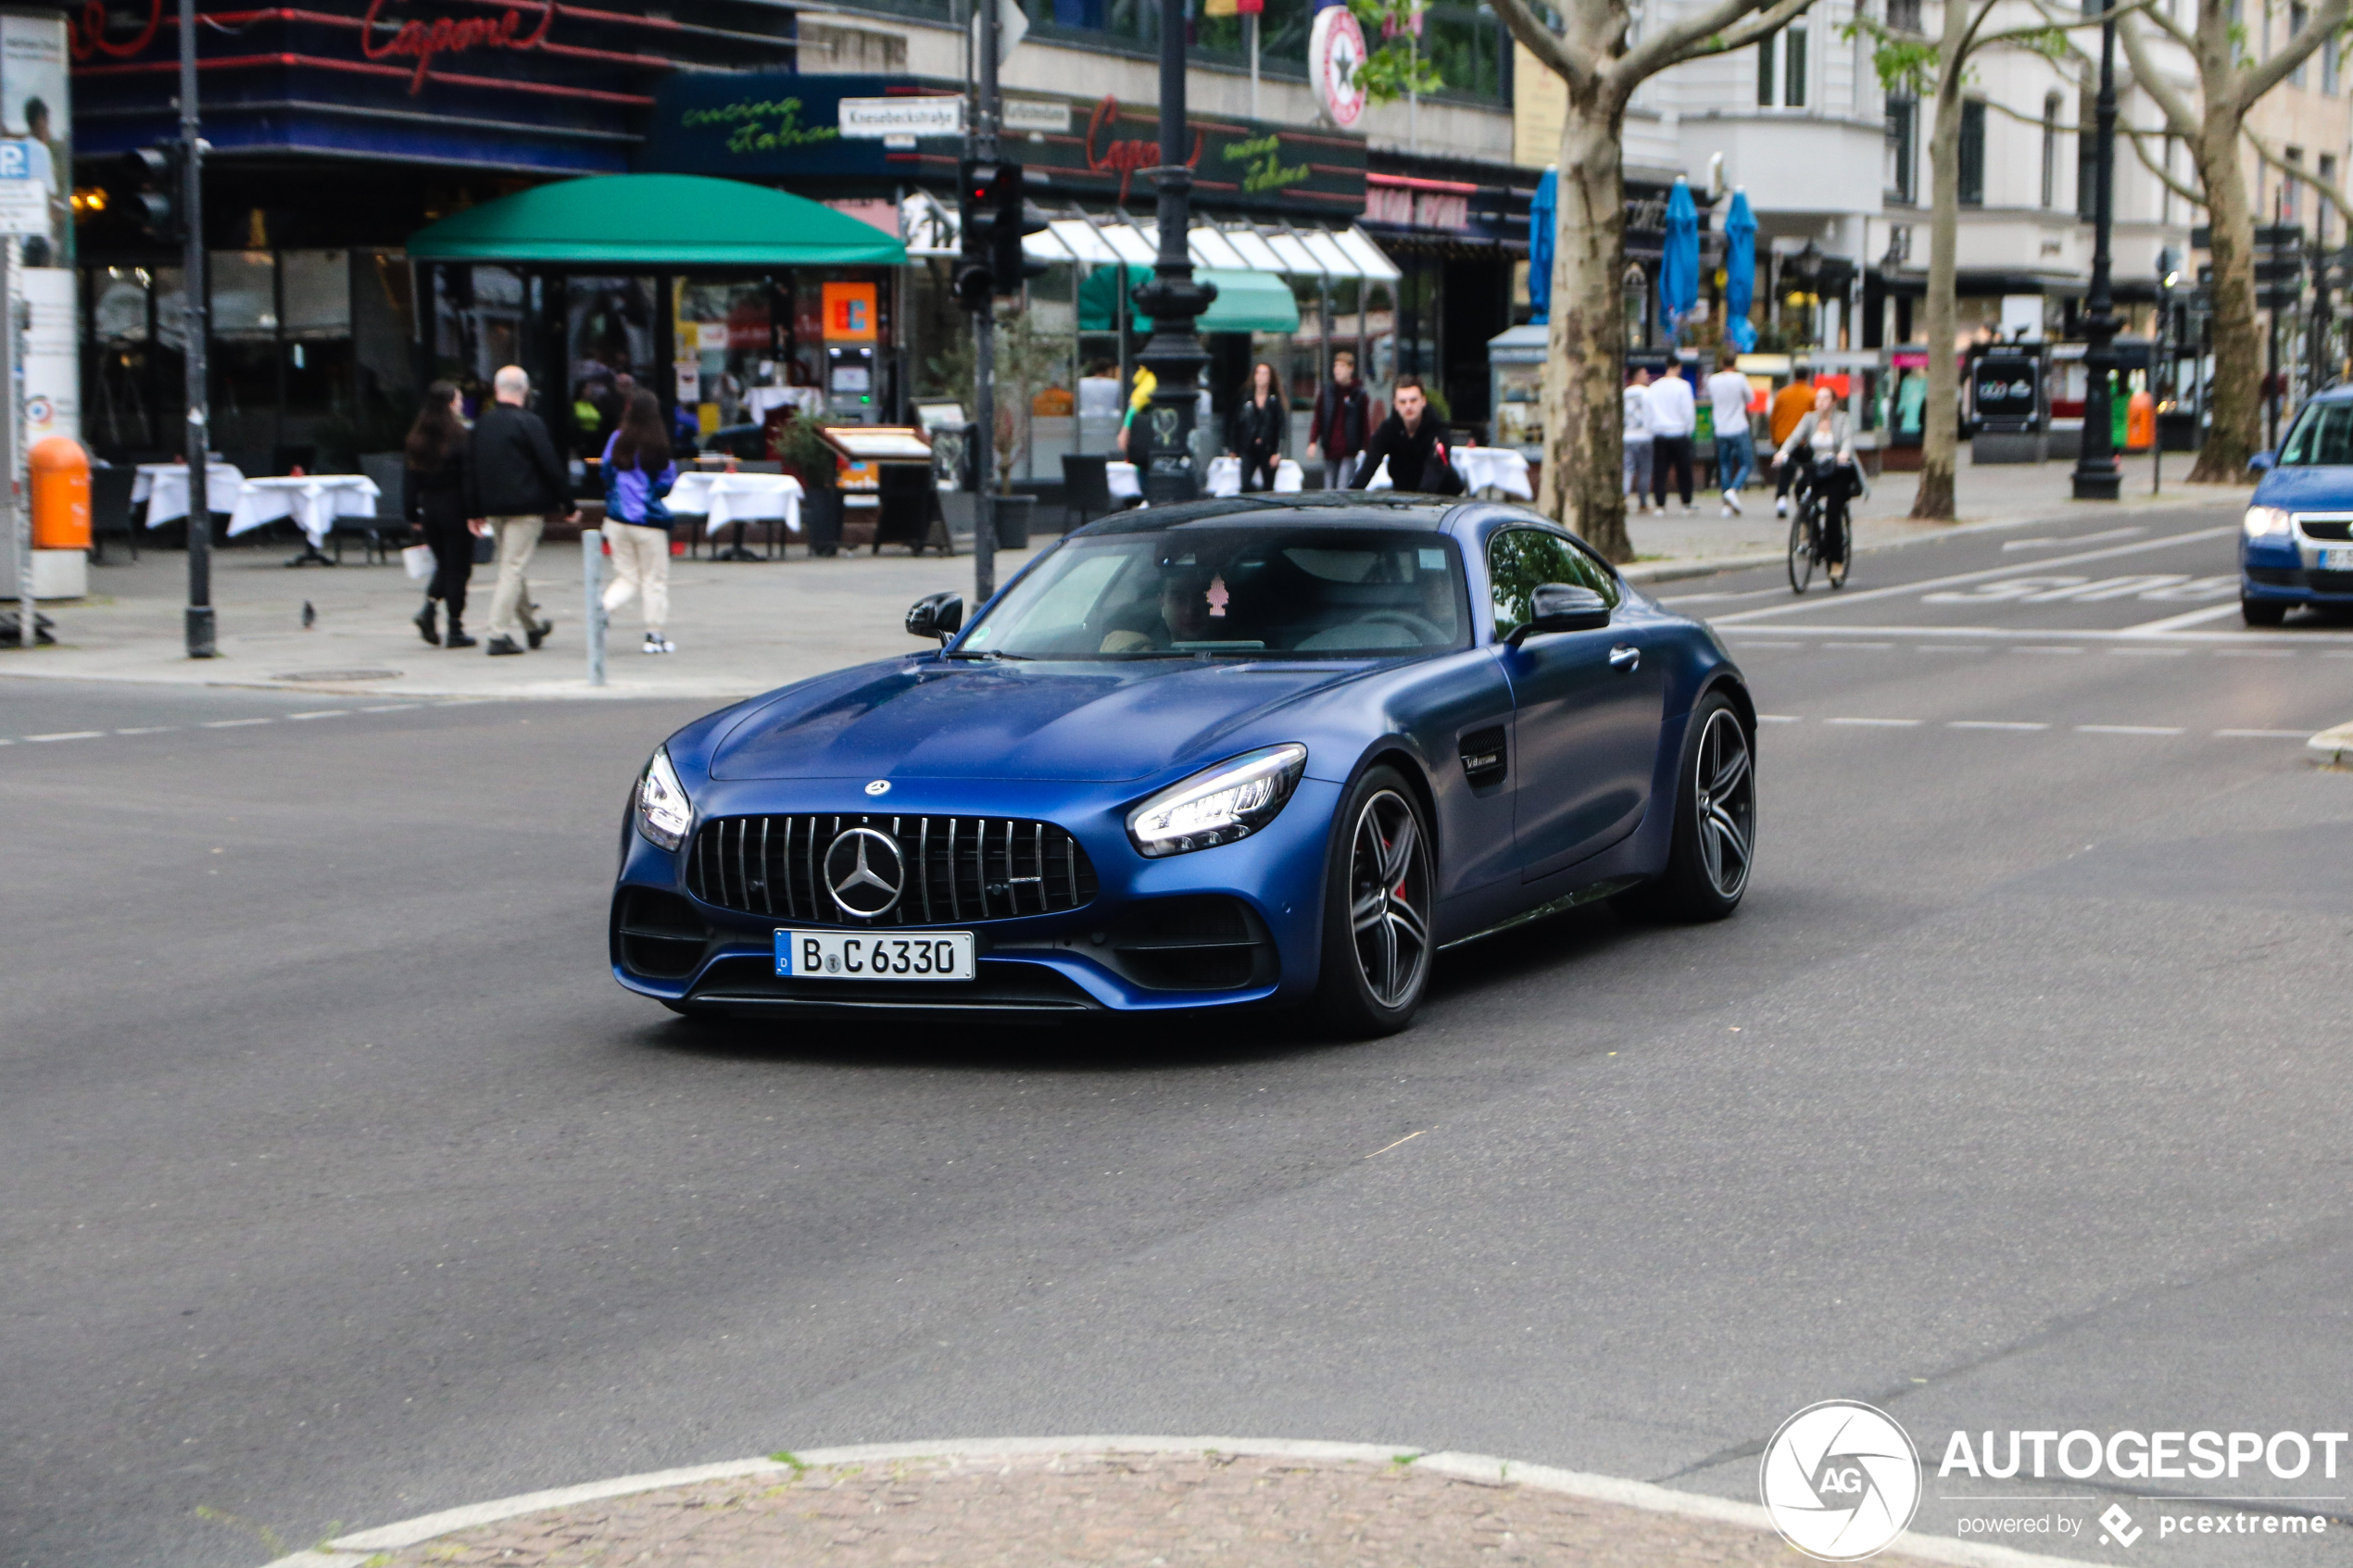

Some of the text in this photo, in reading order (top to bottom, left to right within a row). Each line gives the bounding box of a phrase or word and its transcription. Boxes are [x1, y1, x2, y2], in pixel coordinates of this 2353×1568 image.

[780, 958, 787, 968] D
[802, 937, 954, 973] B C 6330
